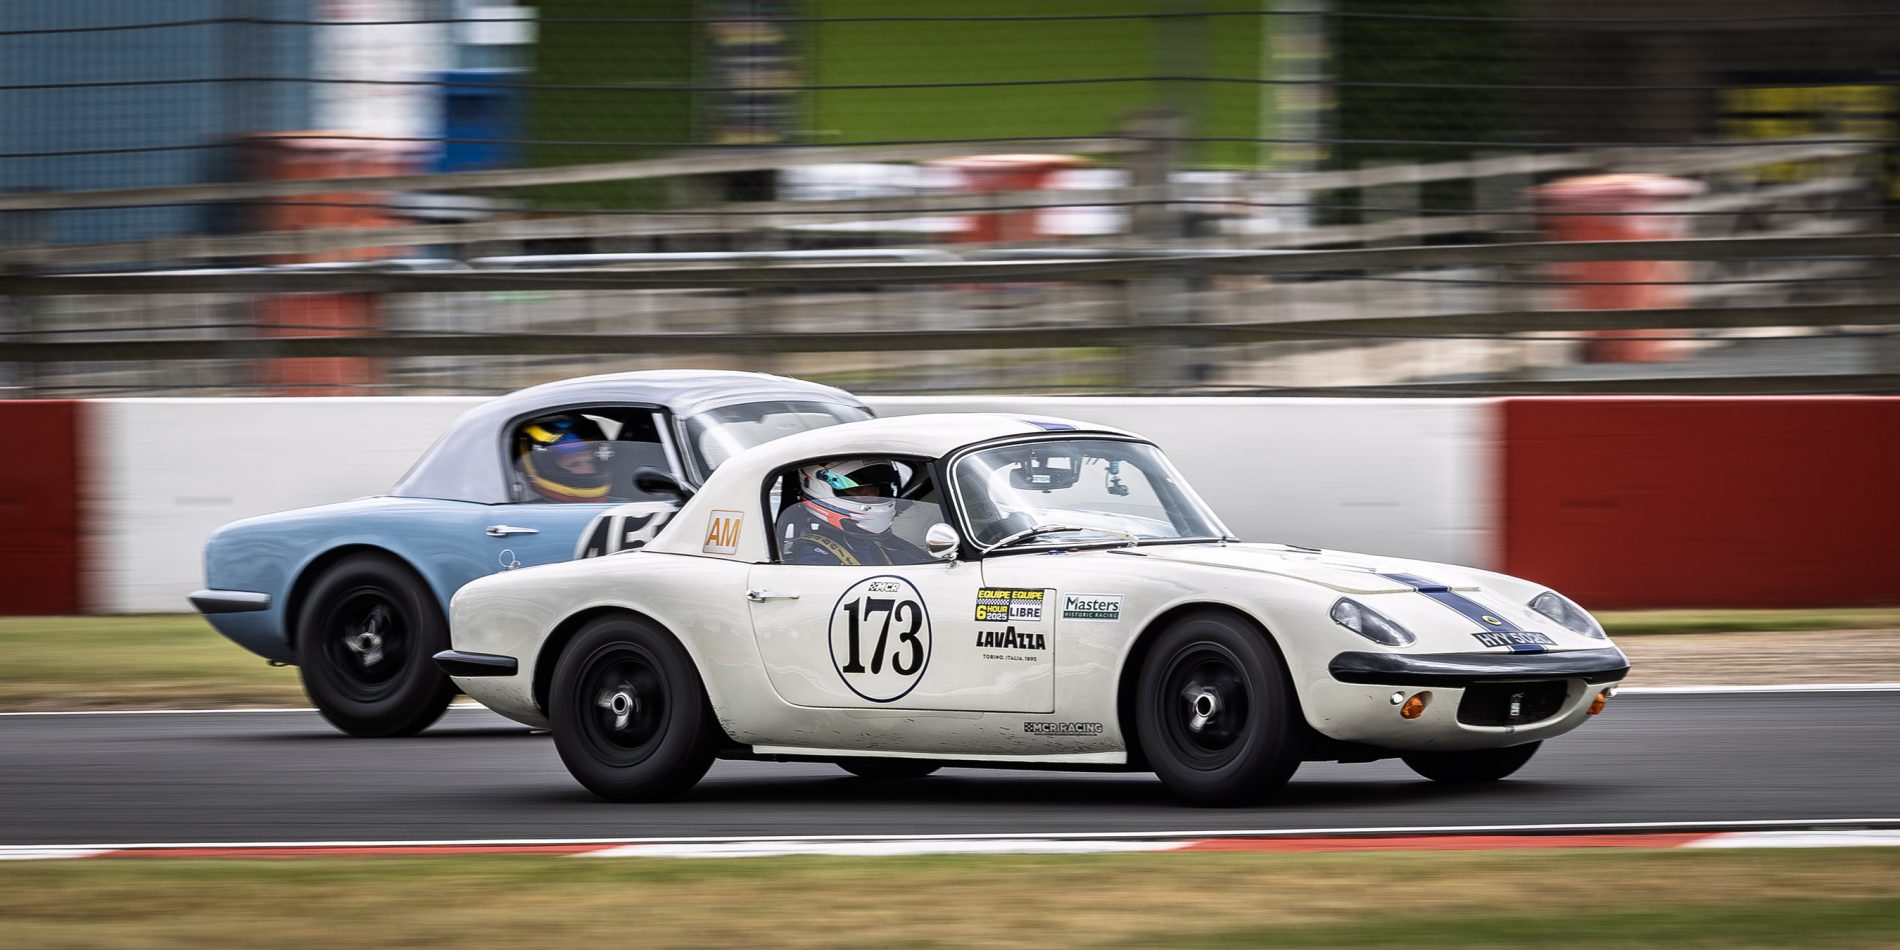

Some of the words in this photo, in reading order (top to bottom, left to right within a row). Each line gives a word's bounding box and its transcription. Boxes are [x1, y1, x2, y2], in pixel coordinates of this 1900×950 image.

[705, 517, 740, 547] AM
[978, 590, 1011, 599] EQUIPE
[1012, 591, 1043, 600] EQUIPE
[1066, 597, 1119, 611] Masters
[976, 605, 986, 620] 6
[987, 605, 1008, 613] HOUR
[1010, 607, 1041, 618] LIBRE
[843, 596, 924, 676] 173
[1477, 633, 1513, 647] HYY
[1033, 723, 1057, 732] MCR
[1059, 723, 1103, 733] RACING
